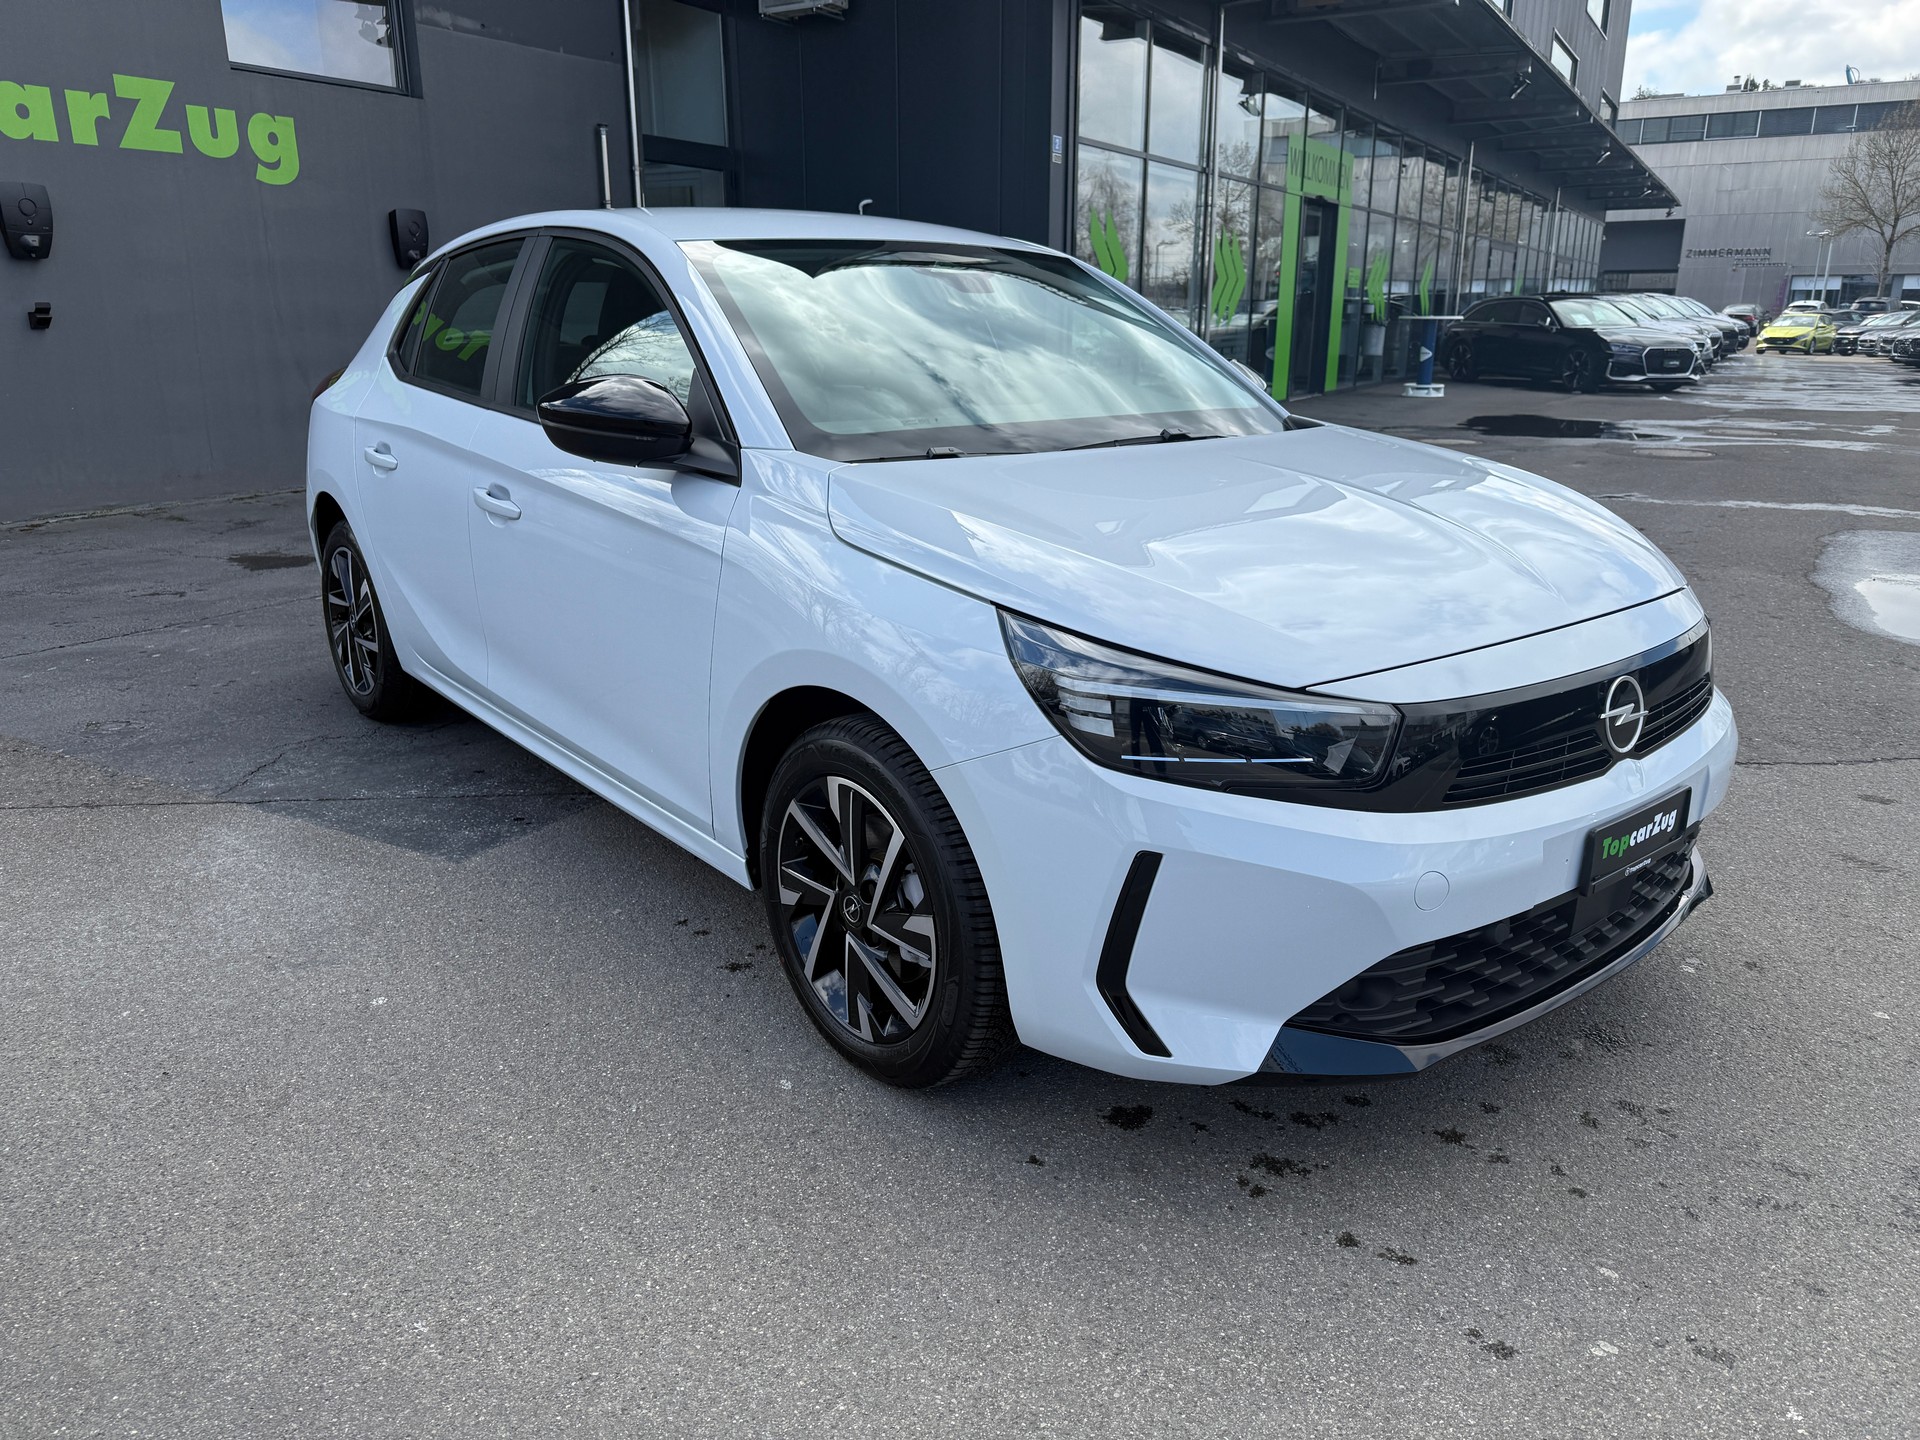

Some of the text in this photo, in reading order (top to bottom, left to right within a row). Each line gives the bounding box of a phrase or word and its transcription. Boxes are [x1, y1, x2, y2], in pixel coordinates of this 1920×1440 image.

[0, 73, 300, 186] arZug
[1685, 247, 1772, 259] ZIMMERMANN
[1602, 809, 1678, 860] TopcarZug
